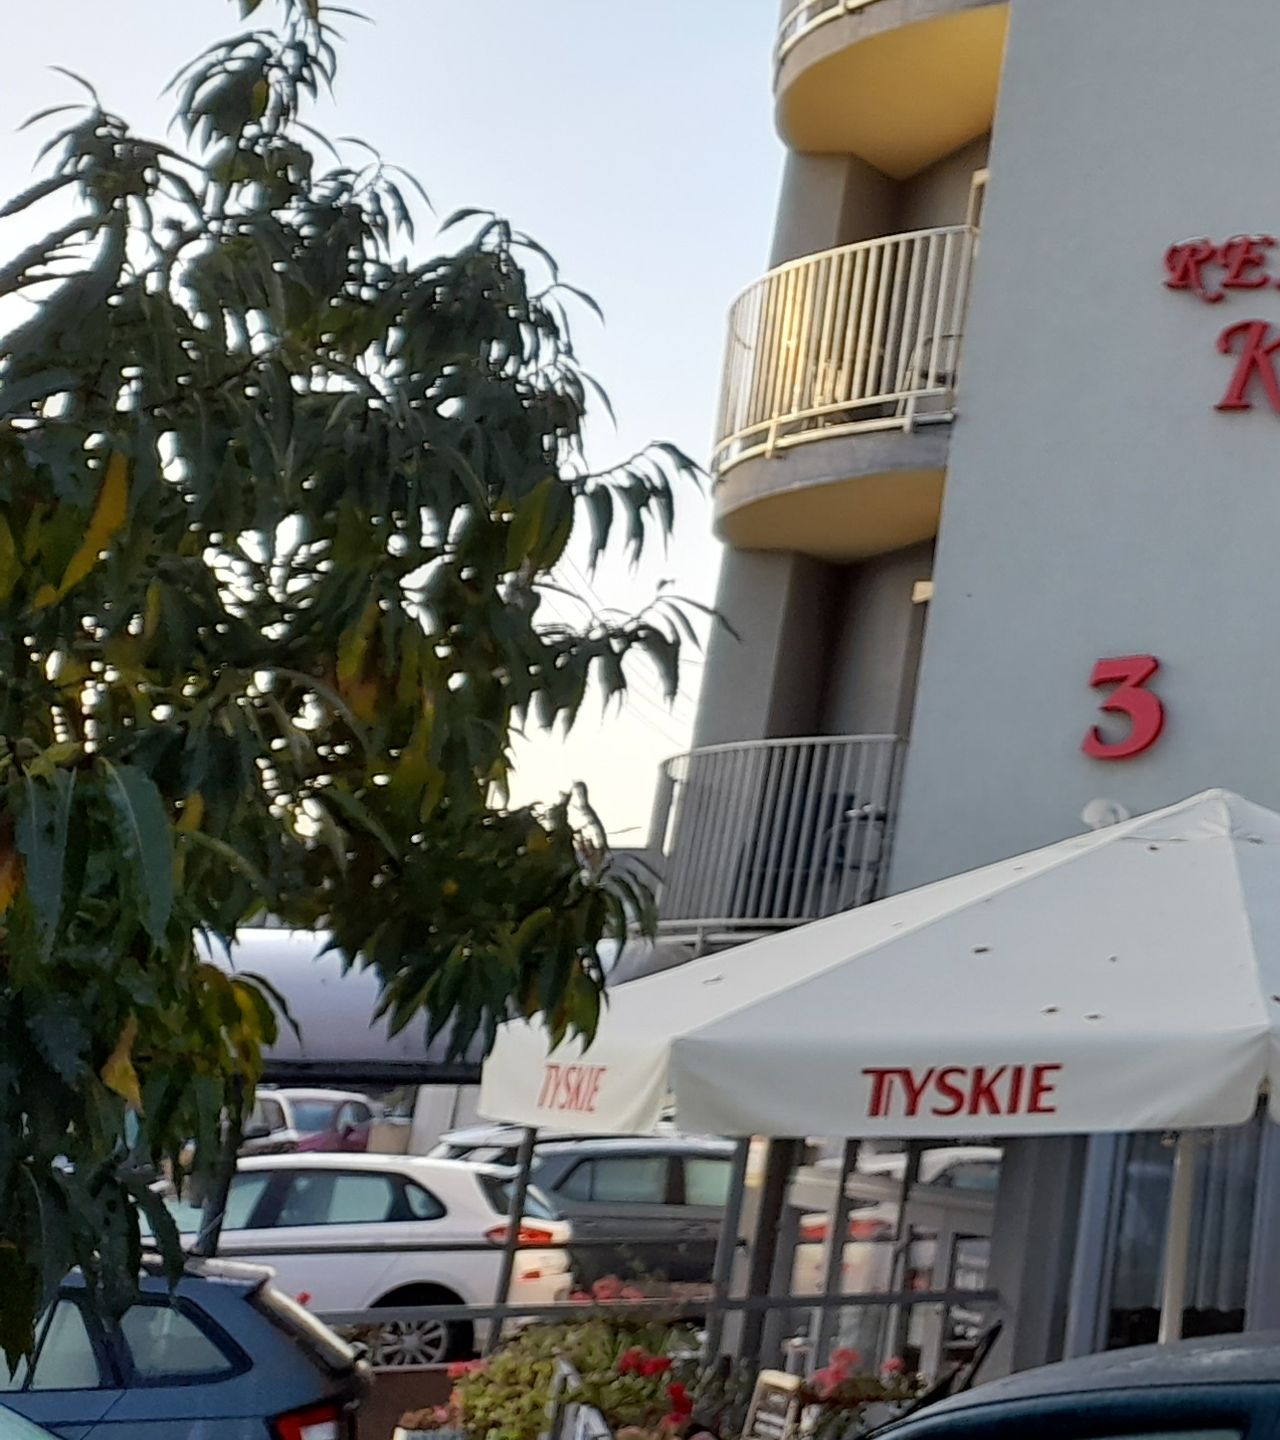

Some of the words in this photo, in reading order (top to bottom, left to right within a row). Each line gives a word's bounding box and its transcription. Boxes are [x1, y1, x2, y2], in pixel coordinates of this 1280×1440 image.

[1082, 655, 1166, 762] 3
[536, 1063, 607, 1115] TYSKIE
[862, 1063, 1063, 1118] TYSKIE
